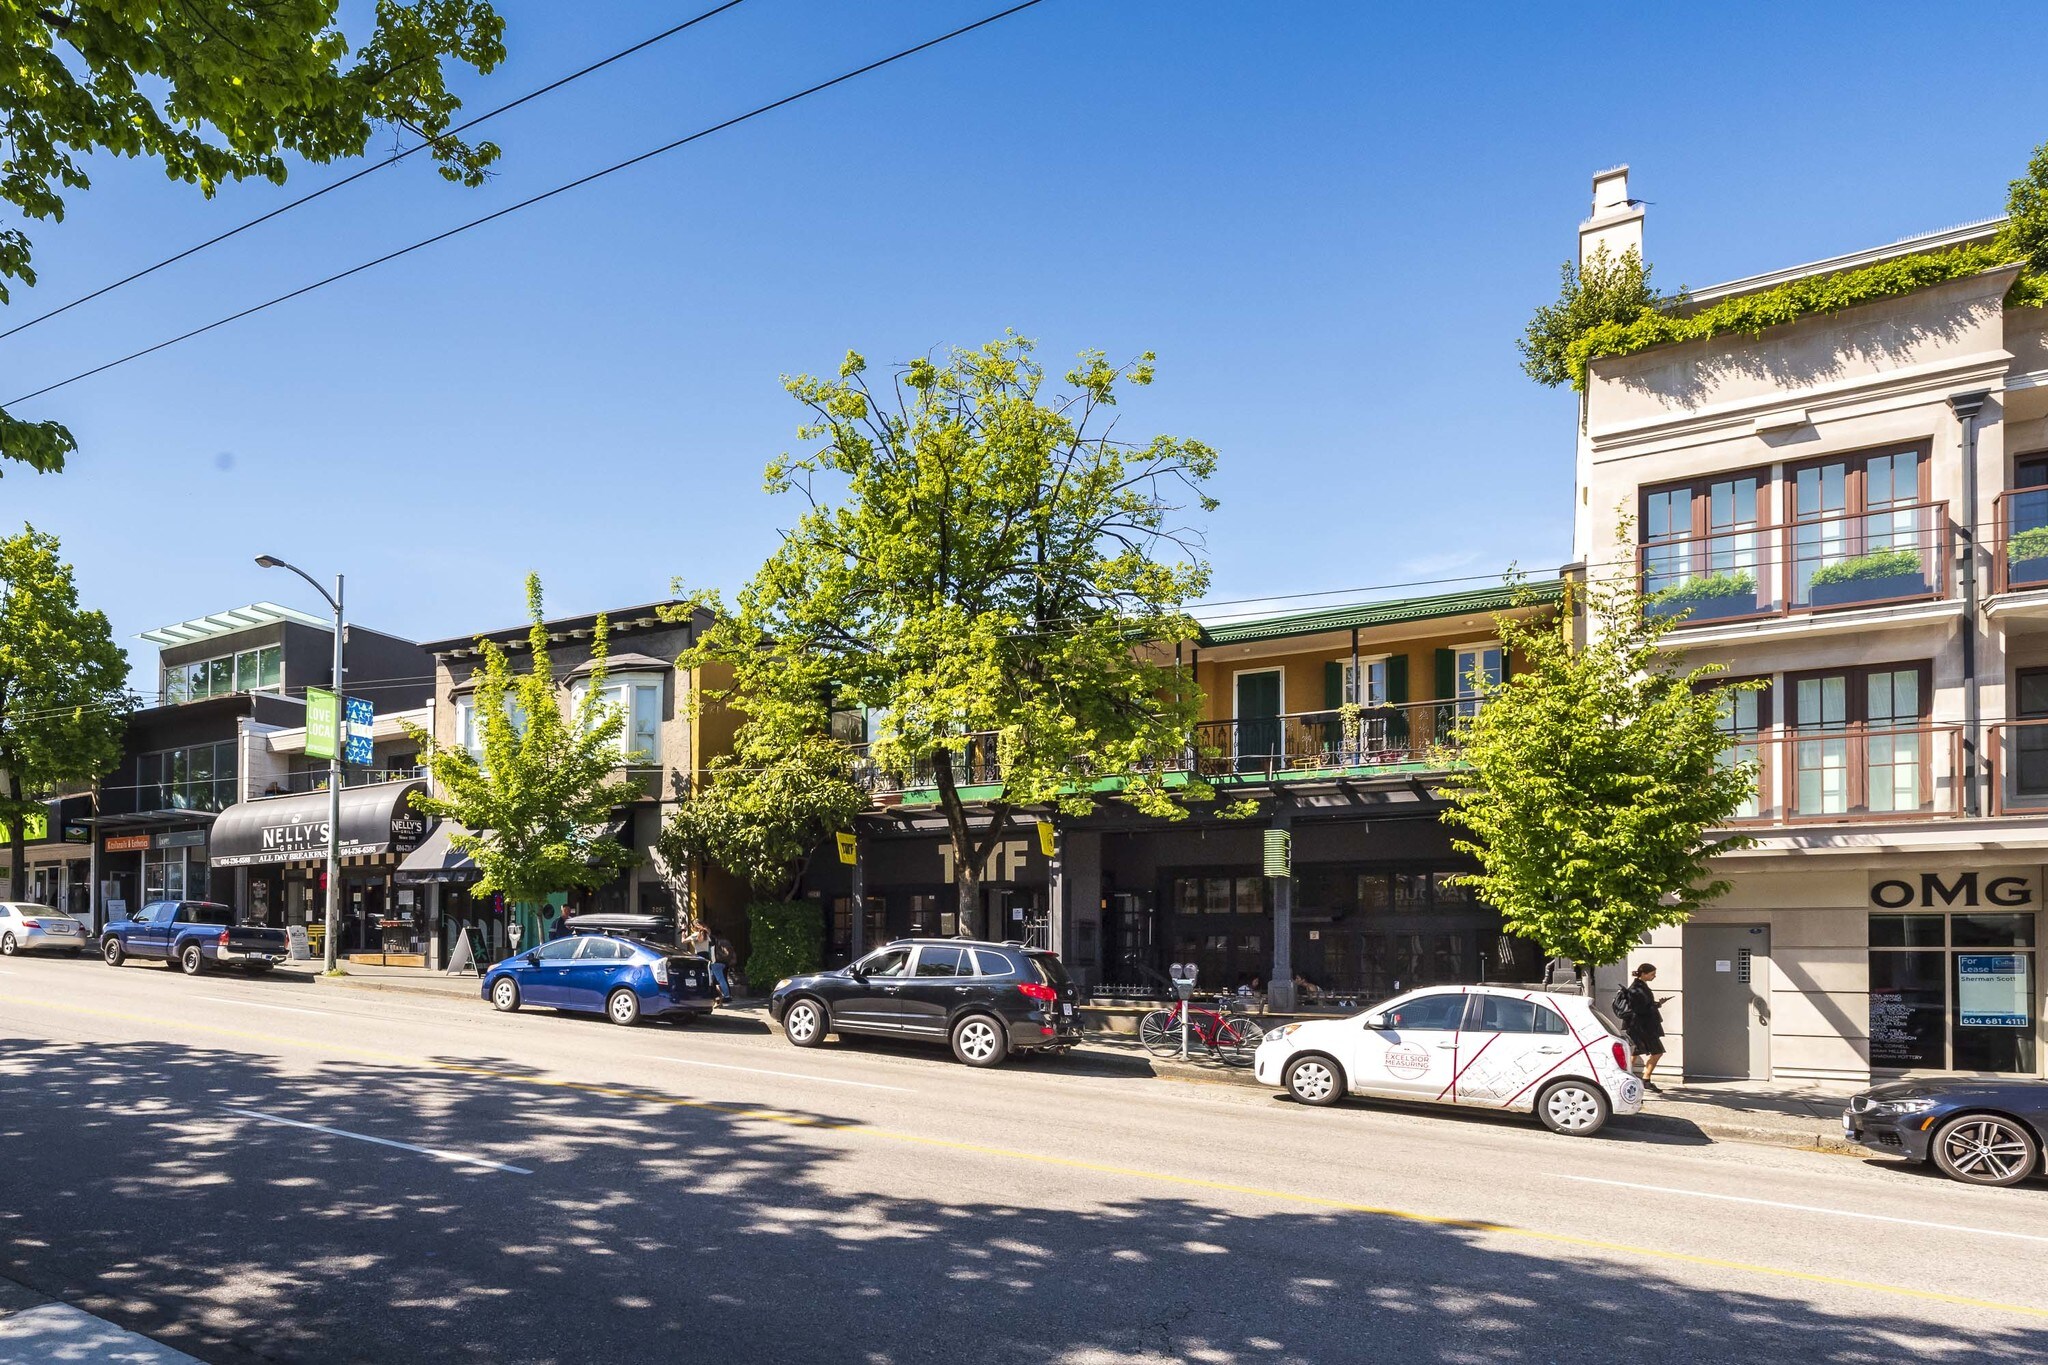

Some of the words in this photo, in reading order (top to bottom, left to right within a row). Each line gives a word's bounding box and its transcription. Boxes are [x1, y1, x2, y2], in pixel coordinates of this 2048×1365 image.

[308, 707, 331, 722] LOVE
[308, 722, 335, 738] LOCAL
[391, 820, 422, 832] NELLY'S
[263, 823, 330, 848] NELLY'S
[280, 842, 312, 852] GRILL
[259, 854, 274, 863] ALL
[274, 853, 289, 861] DAY
[289, 850, 329, 861] BREAKFAS
[1871, 872, 2032, 908] OMG
[1385, 1054, 1429, 1062] EXCELSIOR
[1385, 1060, 1429, 1068] MEASURING
